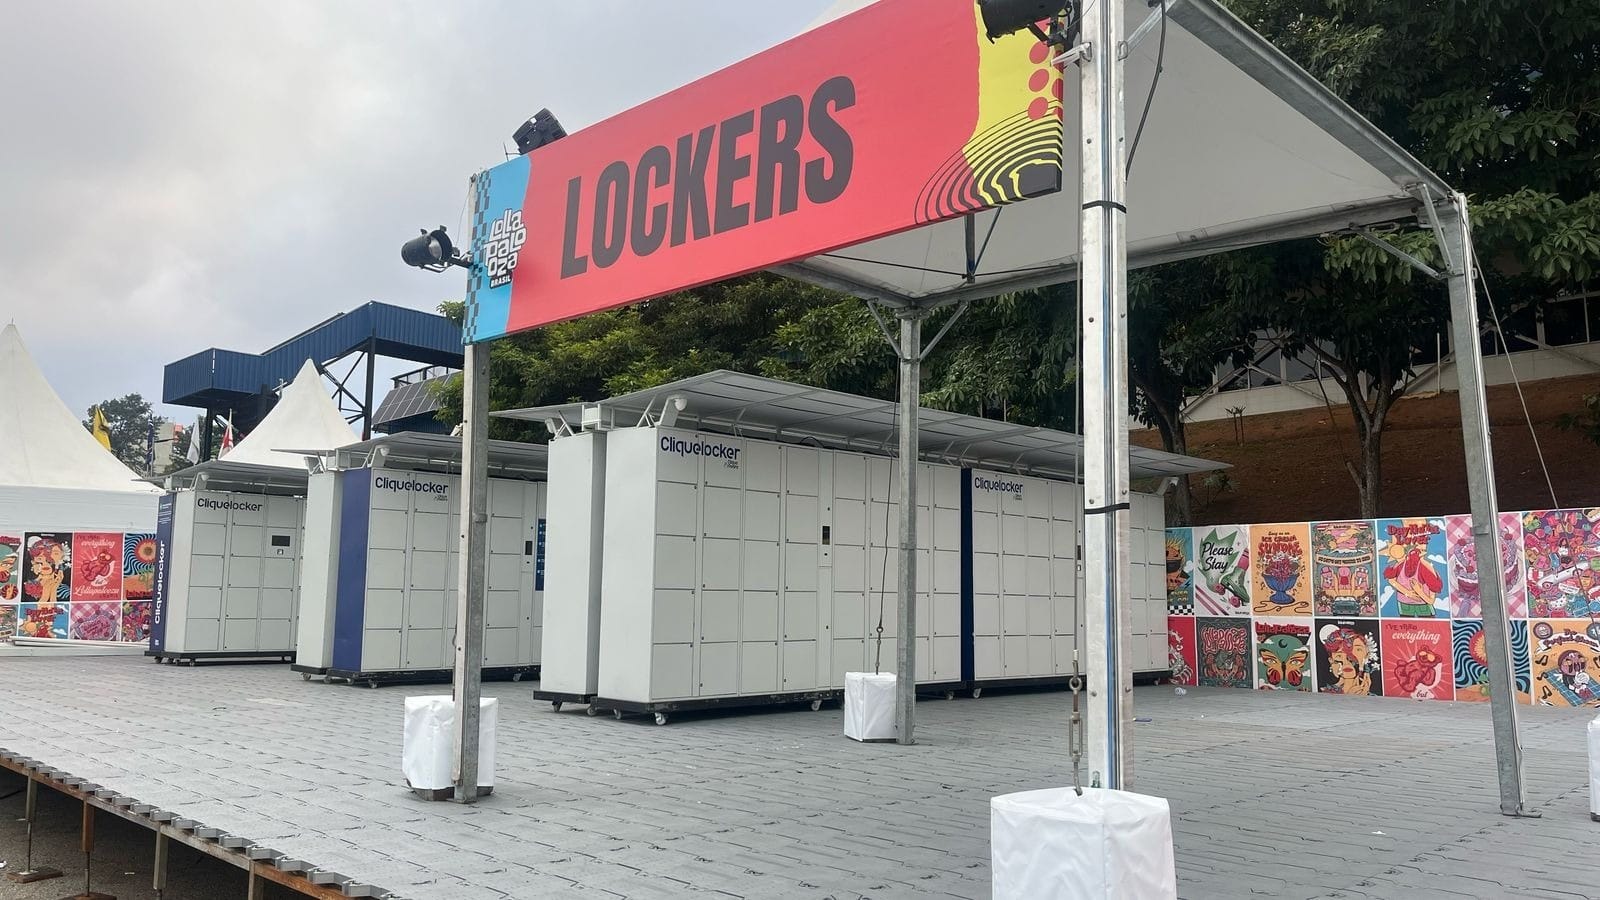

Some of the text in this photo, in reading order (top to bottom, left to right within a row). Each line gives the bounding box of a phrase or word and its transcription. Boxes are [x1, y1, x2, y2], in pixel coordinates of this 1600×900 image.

[560, 76, 857, 280] LOCKERS
[490, 275, 511, 288] BRASIL
[661, 436, 740, 460] Cliquelocker
[375, 477, 449, 494] Cliquelocker
[974, 477, 1024, 493] Cliquelocker
[197, 498, 263, 512] Cliquelocker
[1202, 542, 1233, 557] Please
[1204, 557, 1229, 573] Stay
[154, 540, 165, 624] Cliquelocker
[1392, 629, 1441, 645] everything
